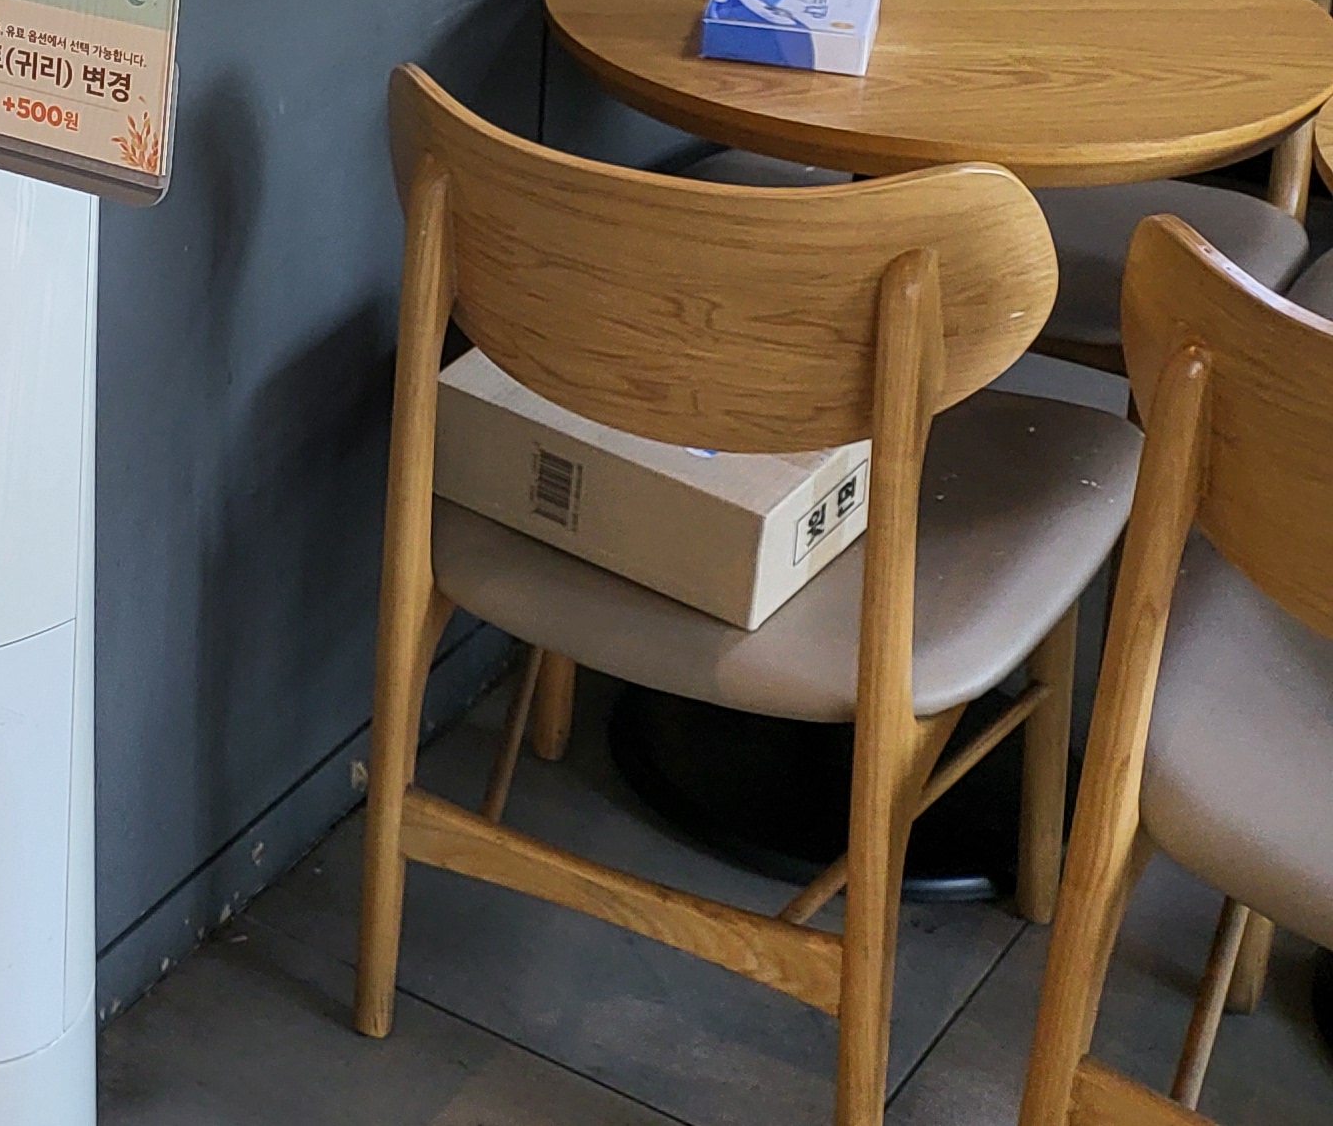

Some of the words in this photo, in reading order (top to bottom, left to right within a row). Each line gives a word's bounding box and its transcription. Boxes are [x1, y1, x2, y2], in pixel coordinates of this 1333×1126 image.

[6, 25, 25, 40] 유료
[28, 28, 67, 49] 옵션에서
[70, 39, 90, 56] 선택
[93, 43, 147, 68] 가능합니다.
[82, 64, 131, 103] 변경
[3, 96, 80, 132] +500원
